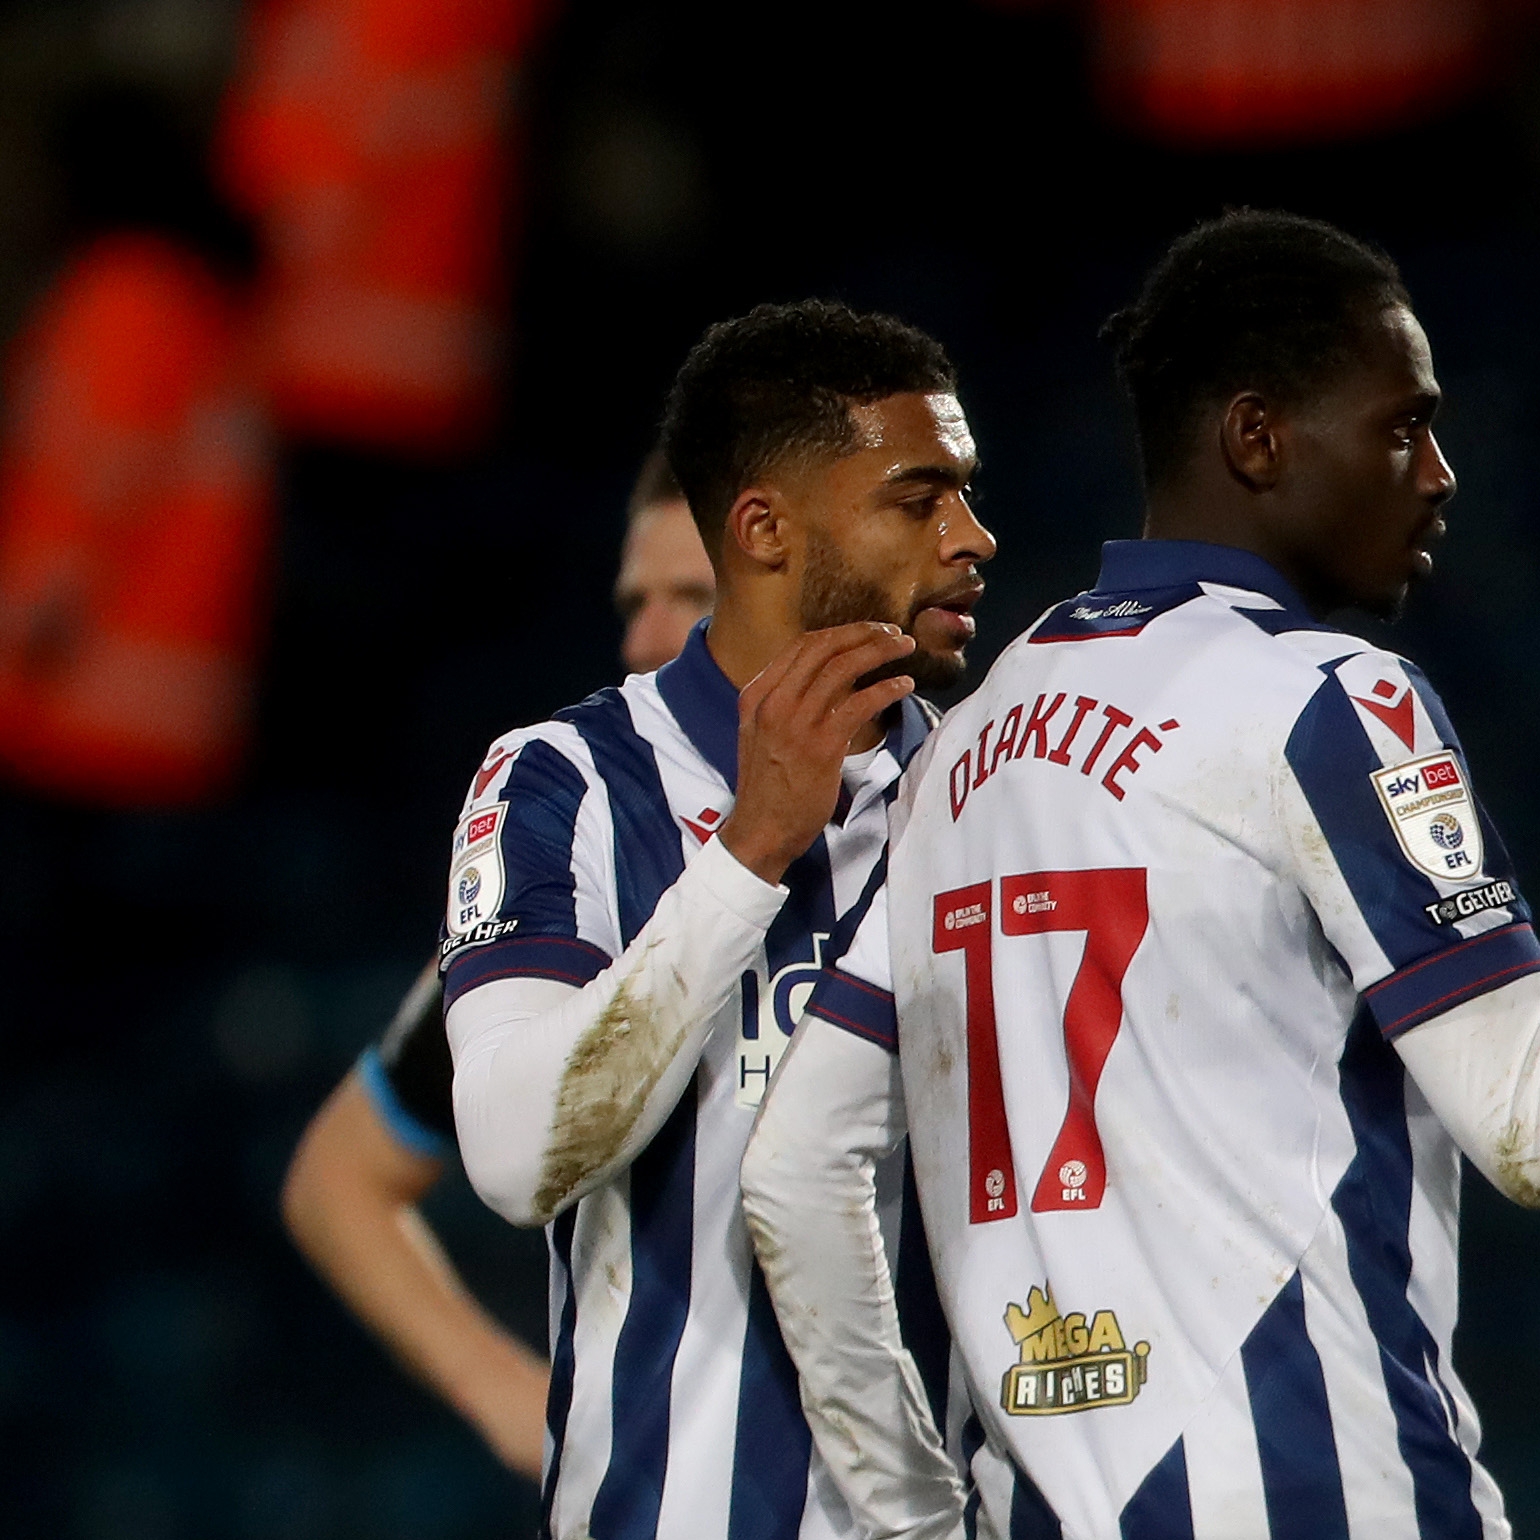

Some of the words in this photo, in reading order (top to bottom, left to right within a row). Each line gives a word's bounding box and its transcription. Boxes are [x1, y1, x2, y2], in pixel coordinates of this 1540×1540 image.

[949, 693, 1181, 823] DIAKITÉ
[1386, 773, 1420, 797] sky
[1424, 764, 1455, 785] bet
[469, 816, 494, 839] bet
[1445, 851, 1472, 869] EFL
[460, 905, 482, 926] EFL
[932, 867, 1149, 1225] 17
[987, 1198, 1005, 1212] EFL
[1062, 1188, 1086, 1201] EFL
[1020, 1309, 1126, 1364] MEGA
[1016, 1362, 1124, 1406] RICHES
